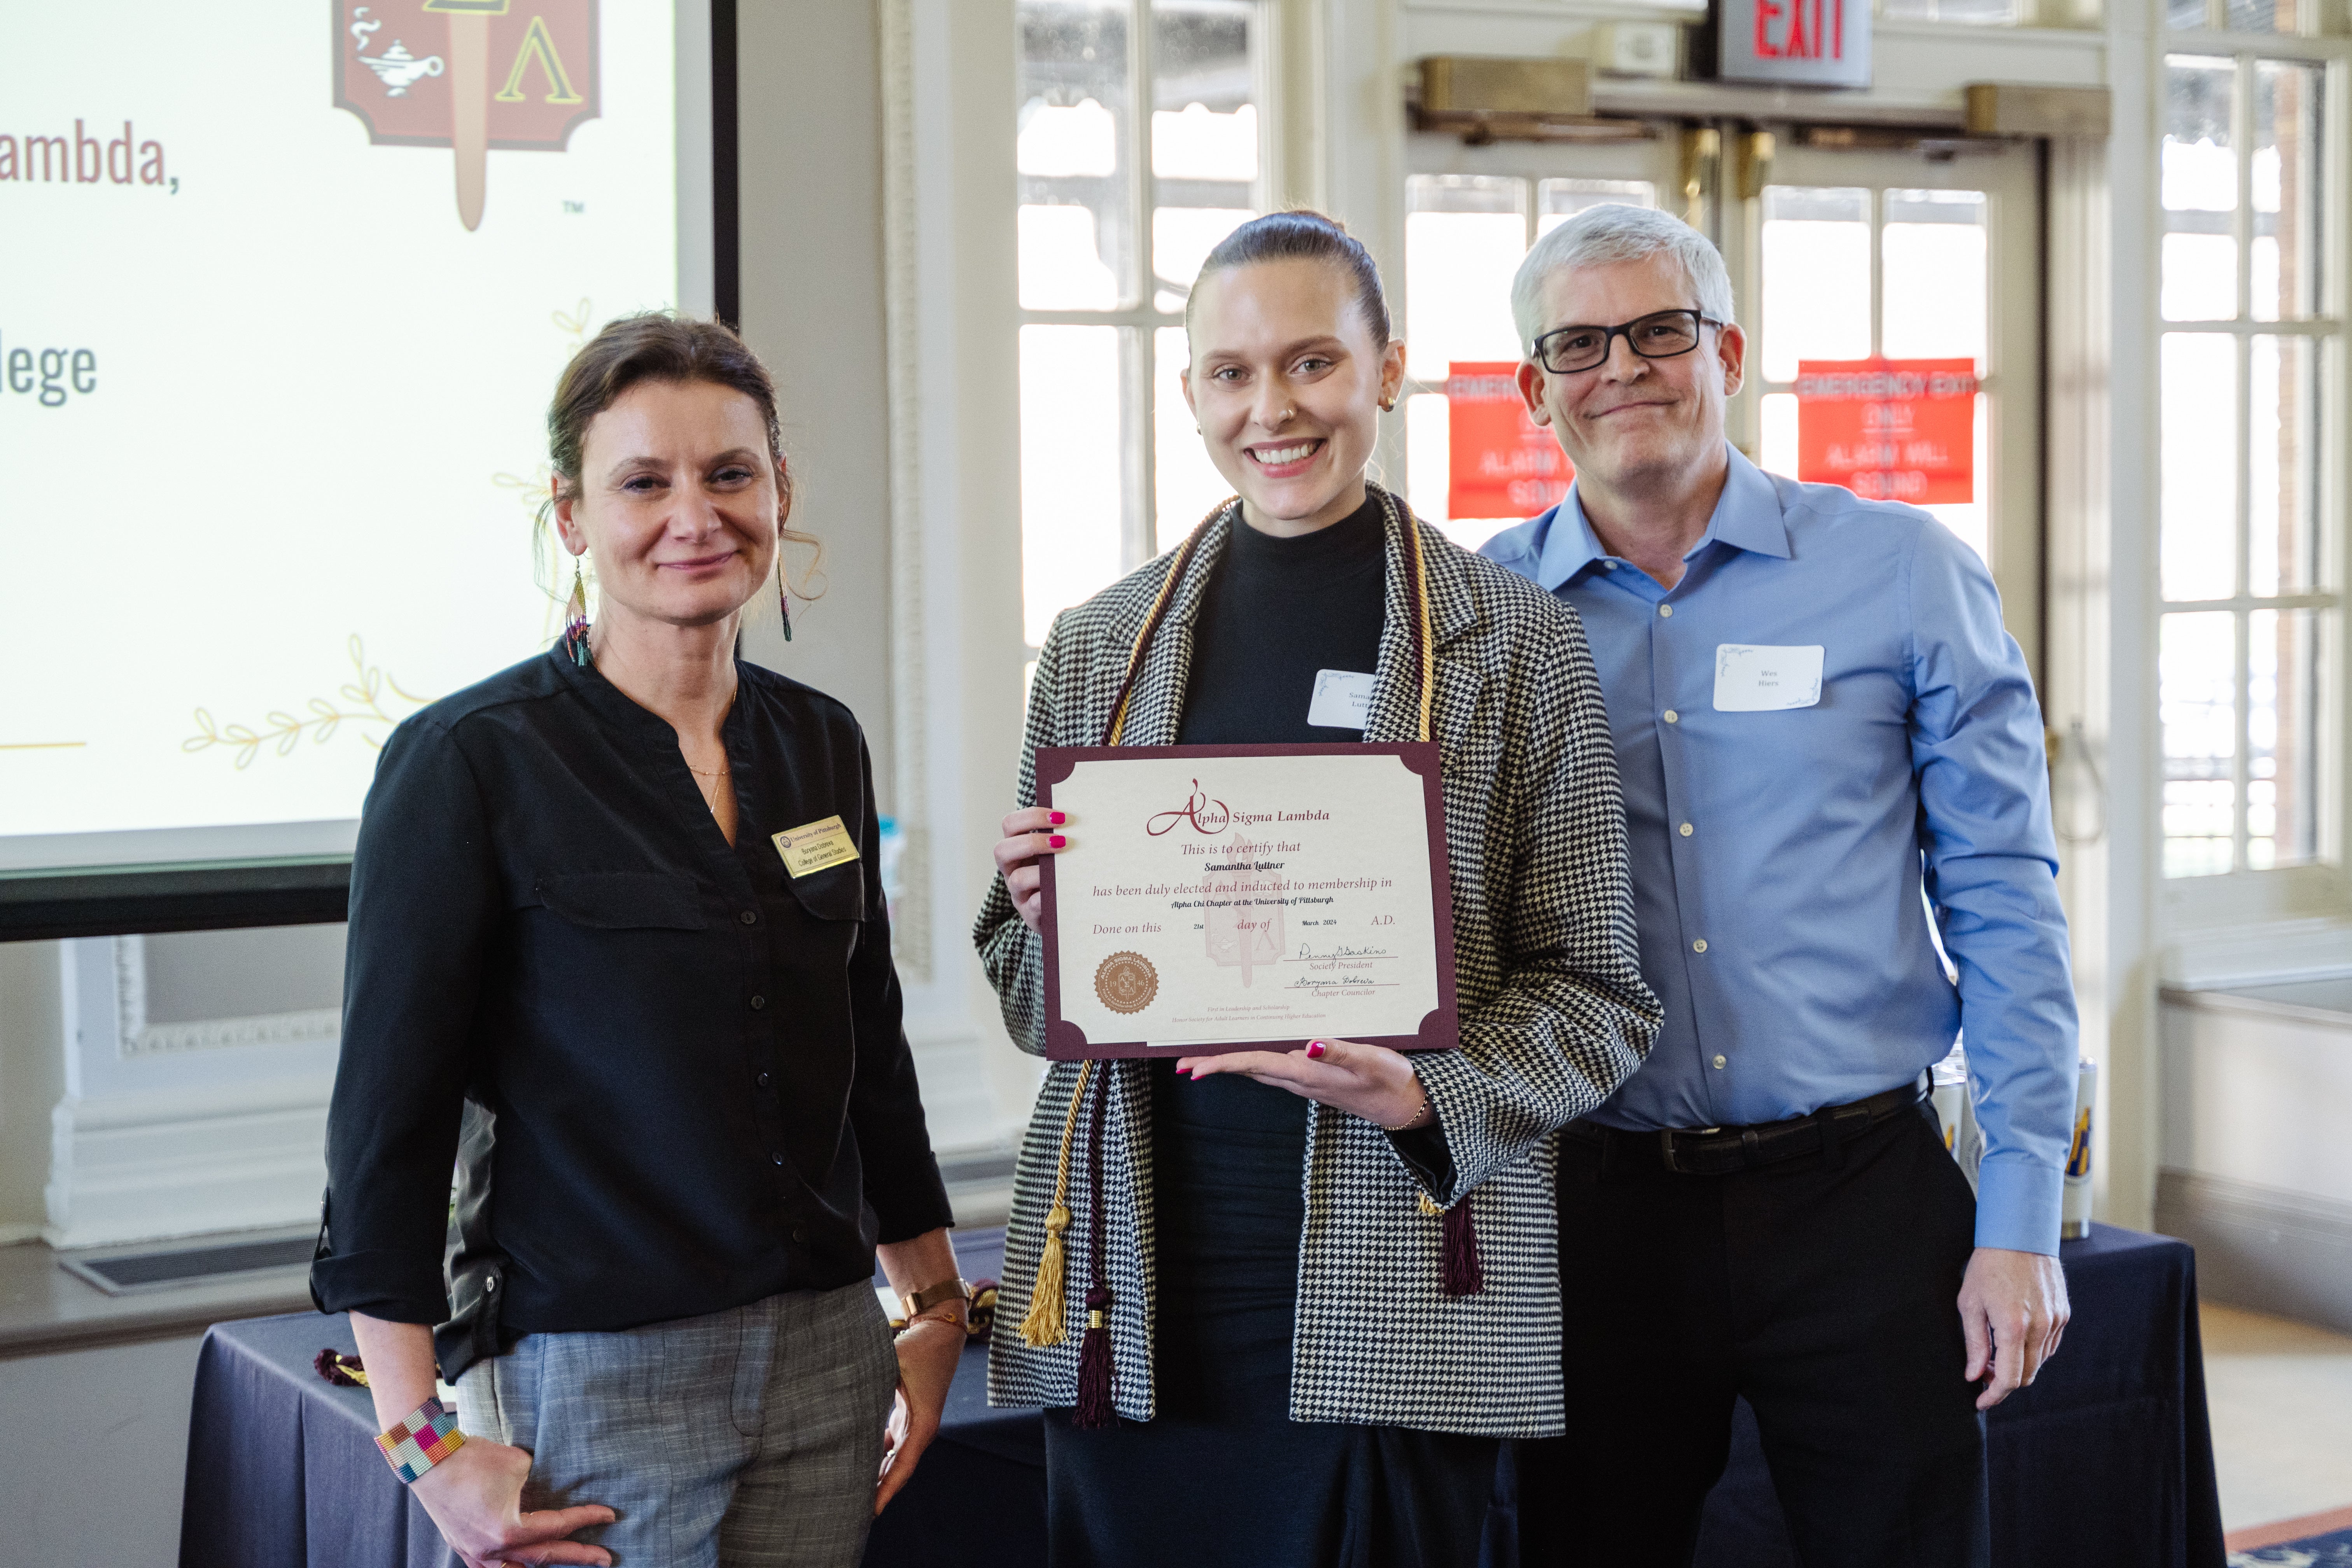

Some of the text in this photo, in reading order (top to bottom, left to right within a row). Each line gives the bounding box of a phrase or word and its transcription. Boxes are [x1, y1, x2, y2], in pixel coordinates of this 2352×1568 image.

[0, 329, 96, 407] ege
[1146, 778, 1330, 836] Alpha Sigma Lambda
[790, 832, 813, 842] University
[818, 823, 841, 833] Pittsburgh
[798, 858, 813, 866] College
[817, 851, 832, 860] General
[831, 847, 847, 855] Studies
[802, 840, 834, 854] Boryana Dobreva
[1181, 841, 1301, 856] This is to certify that
[1205, 861, 1285, 872] Samantha Luttner
[1093, 877, 1392, 897] has been duly elected and inducted to membership in
[1171, 900, 1192, 909] Alpha
[1206, 899, 1232, 908] Chapter
[1254, 897, 1289, 906] University
[1290, 897, 1297, 905] of
[1298, 896, 1334, 905] Pittsburgh
[1092, 924, 1122, 934] Done
[1142, 922, 1162, 933] this
[1237, 919, 1257, 933] day
[1260, 918, 1272, 932] of
[1371, 915, 1396, 926] A.D.
[1101, 961, 1114, 980] ALPHA
[1133, 958, 1152, 978] LAMBDA
[1309, 961, 1373, 971] Society President
[1312, 990, 1340, 998] Chapter
